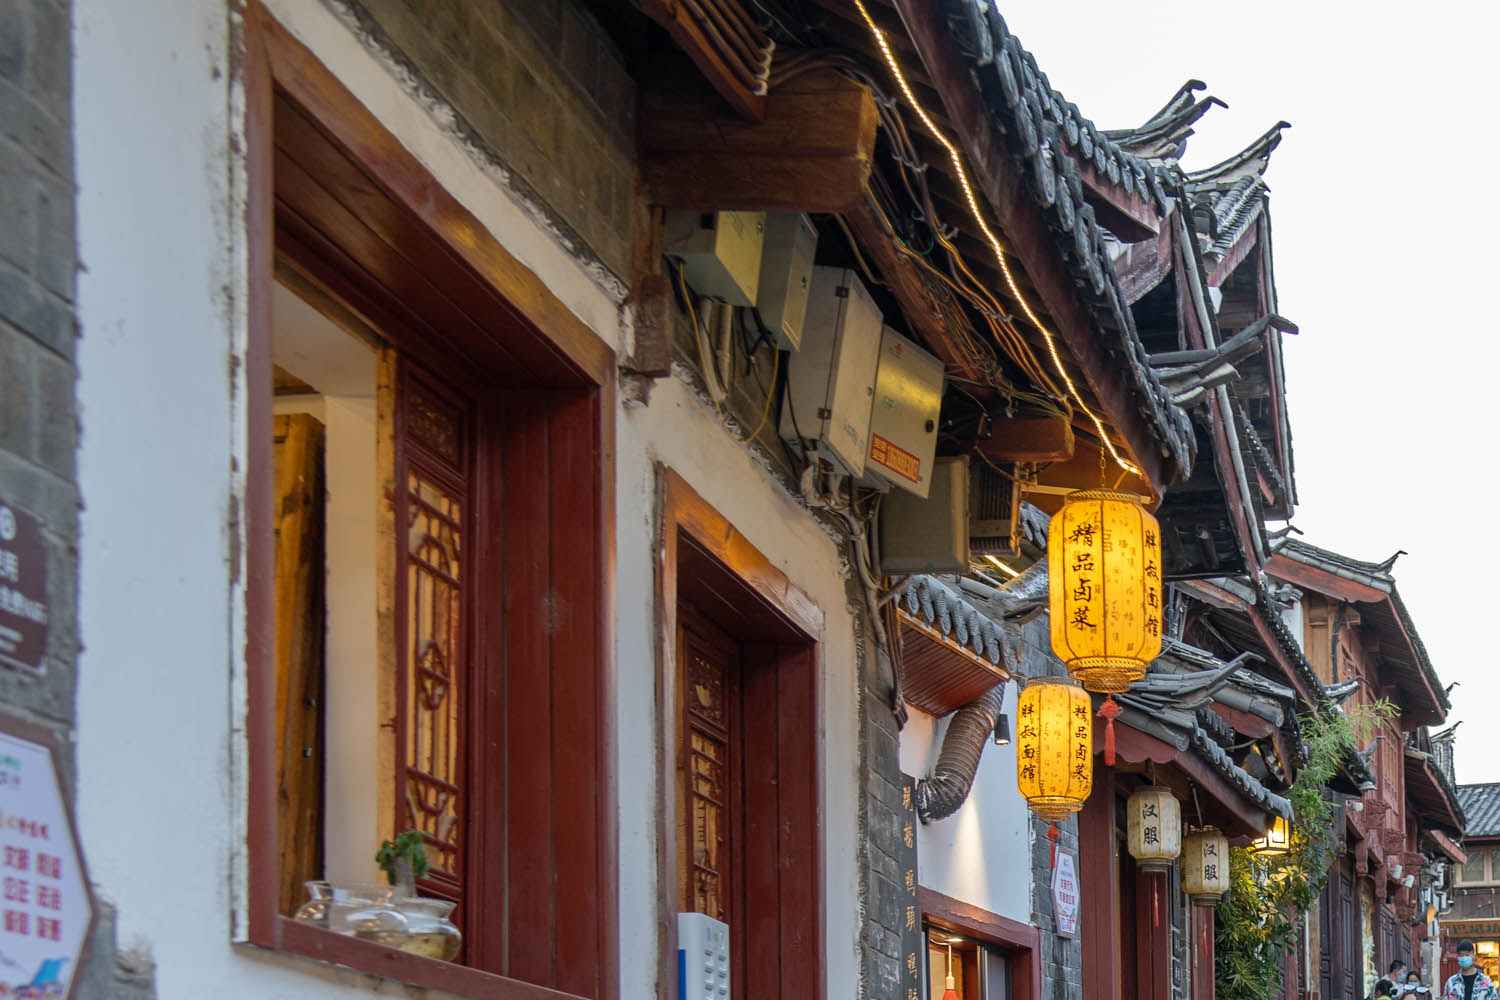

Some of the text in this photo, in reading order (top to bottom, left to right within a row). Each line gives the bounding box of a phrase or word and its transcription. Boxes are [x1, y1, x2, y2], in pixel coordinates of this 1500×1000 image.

[1068, 523, 1097, 632] 精品卤菜
[1020, 703, 1037, 780] 胖叔面馆
[1073, 704, 1089, 780] 精品卤菜
[1142, 803, 1160, 845] 汉服
[1203, 842, 1218, 881] 汉服
